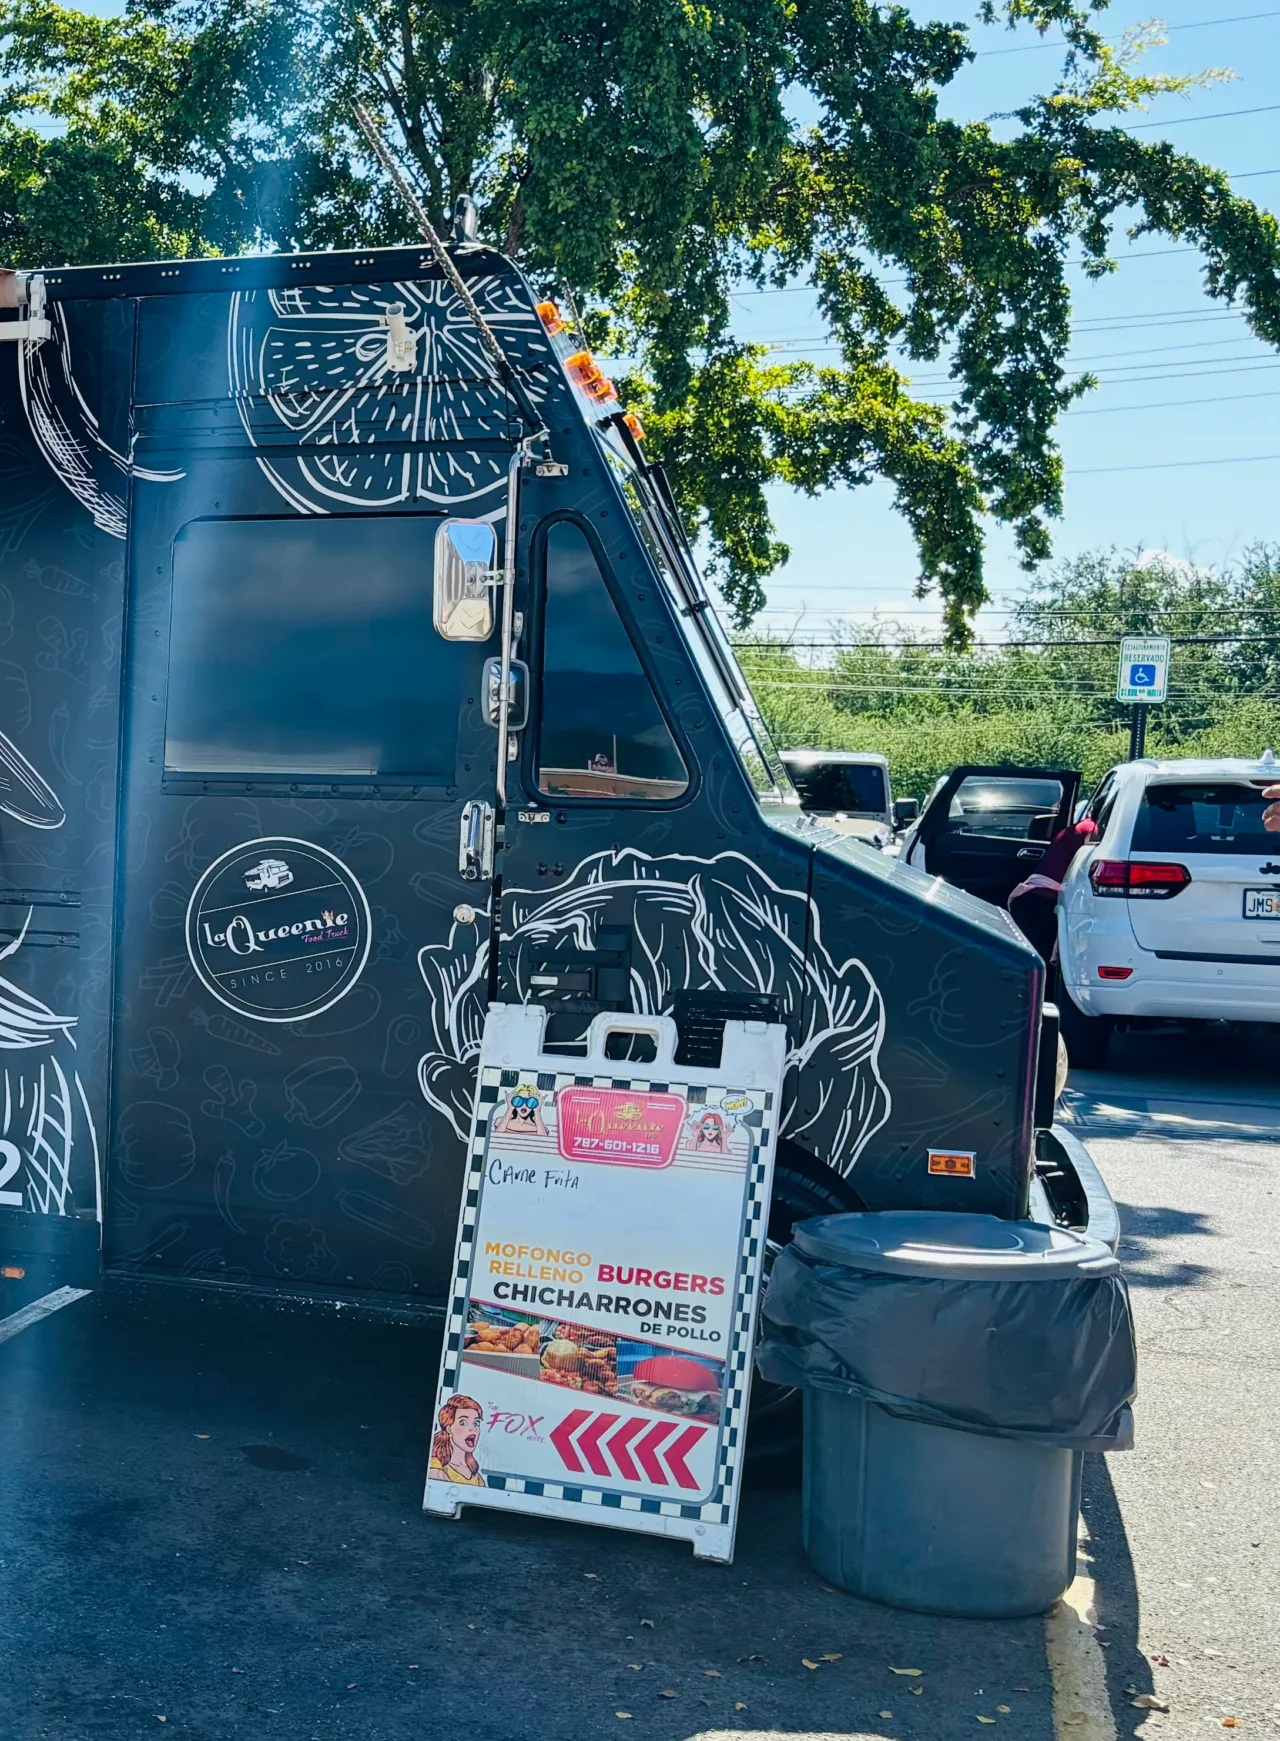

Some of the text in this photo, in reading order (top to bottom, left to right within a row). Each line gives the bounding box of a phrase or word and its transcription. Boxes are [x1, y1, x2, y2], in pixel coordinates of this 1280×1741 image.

[1124, 654, 1164, 662] RESERVADO
[1248, 898, 1273, 913] JMS
[203, 912, 348, 955] La Queenie
[302, 928, 349, 944] Food Truck
[231, 957, 343, 989] SINCE 2016
[574, 1137, 660, 1154] 787-601-1216
[484, 1241, 592, 1267] MOFONGO
[489, 1260, 583, 1284] RELLENO
[597, 1264, 725, 1296] BURGERS
[493, 1281, 707, 1324] CHICHARRONES
[640, 1321, 721, 1342] DE POLLO
[486, 1412, 545, 1437] FOX
